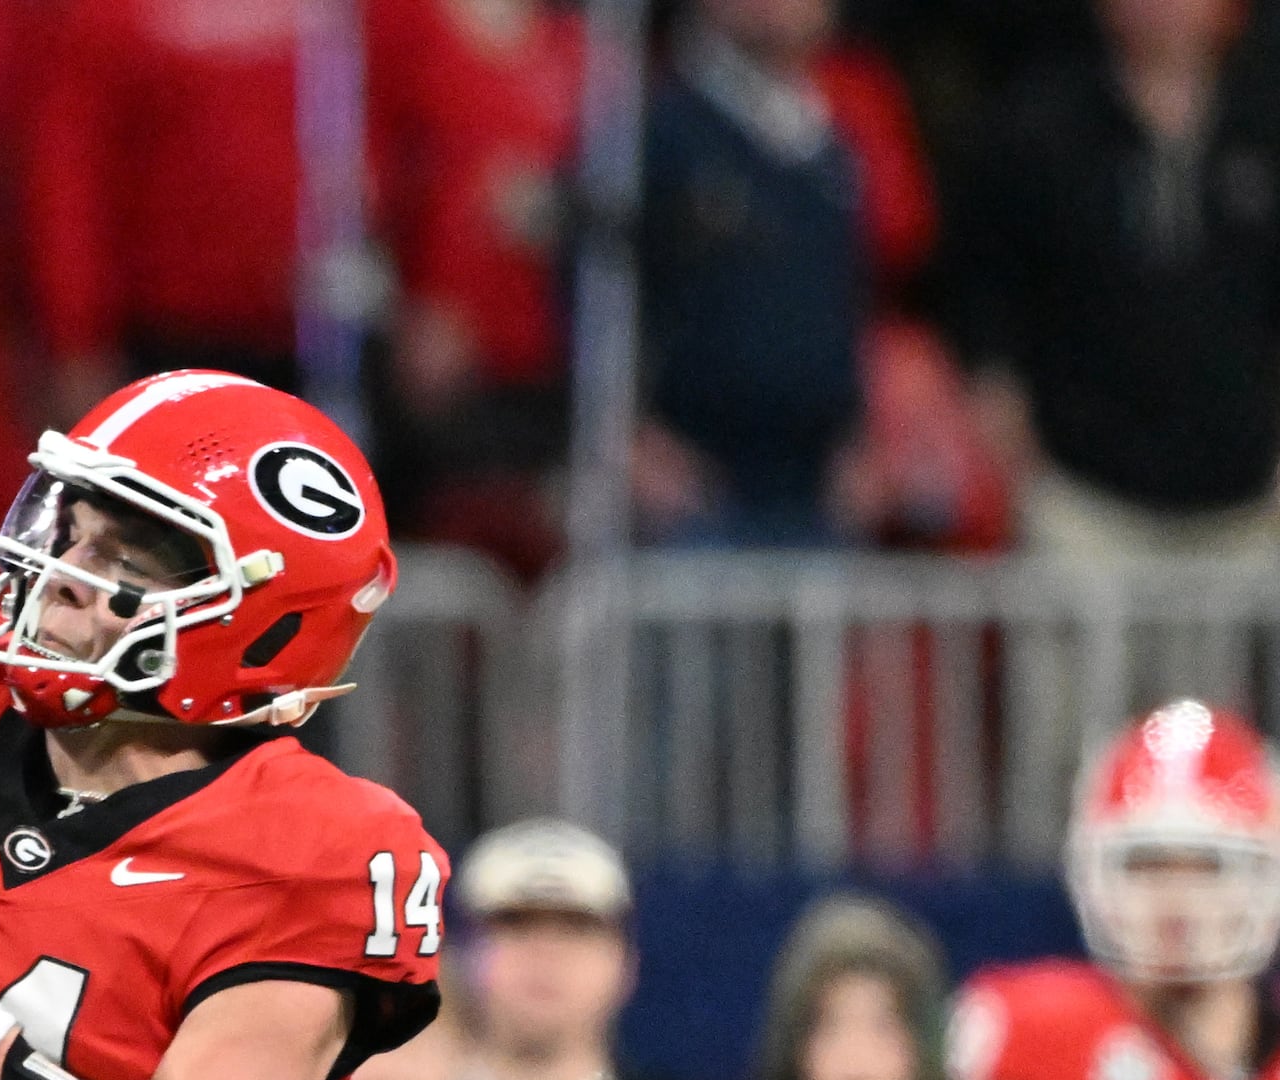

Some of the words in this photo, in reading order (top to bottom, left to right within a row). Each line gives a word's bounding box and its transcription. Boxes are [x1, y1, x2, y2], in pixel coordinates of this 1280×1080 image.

[270, 452, 363, 524] G
[10, 834, 51, 866] G
[364, 850, 441, 958] 14
